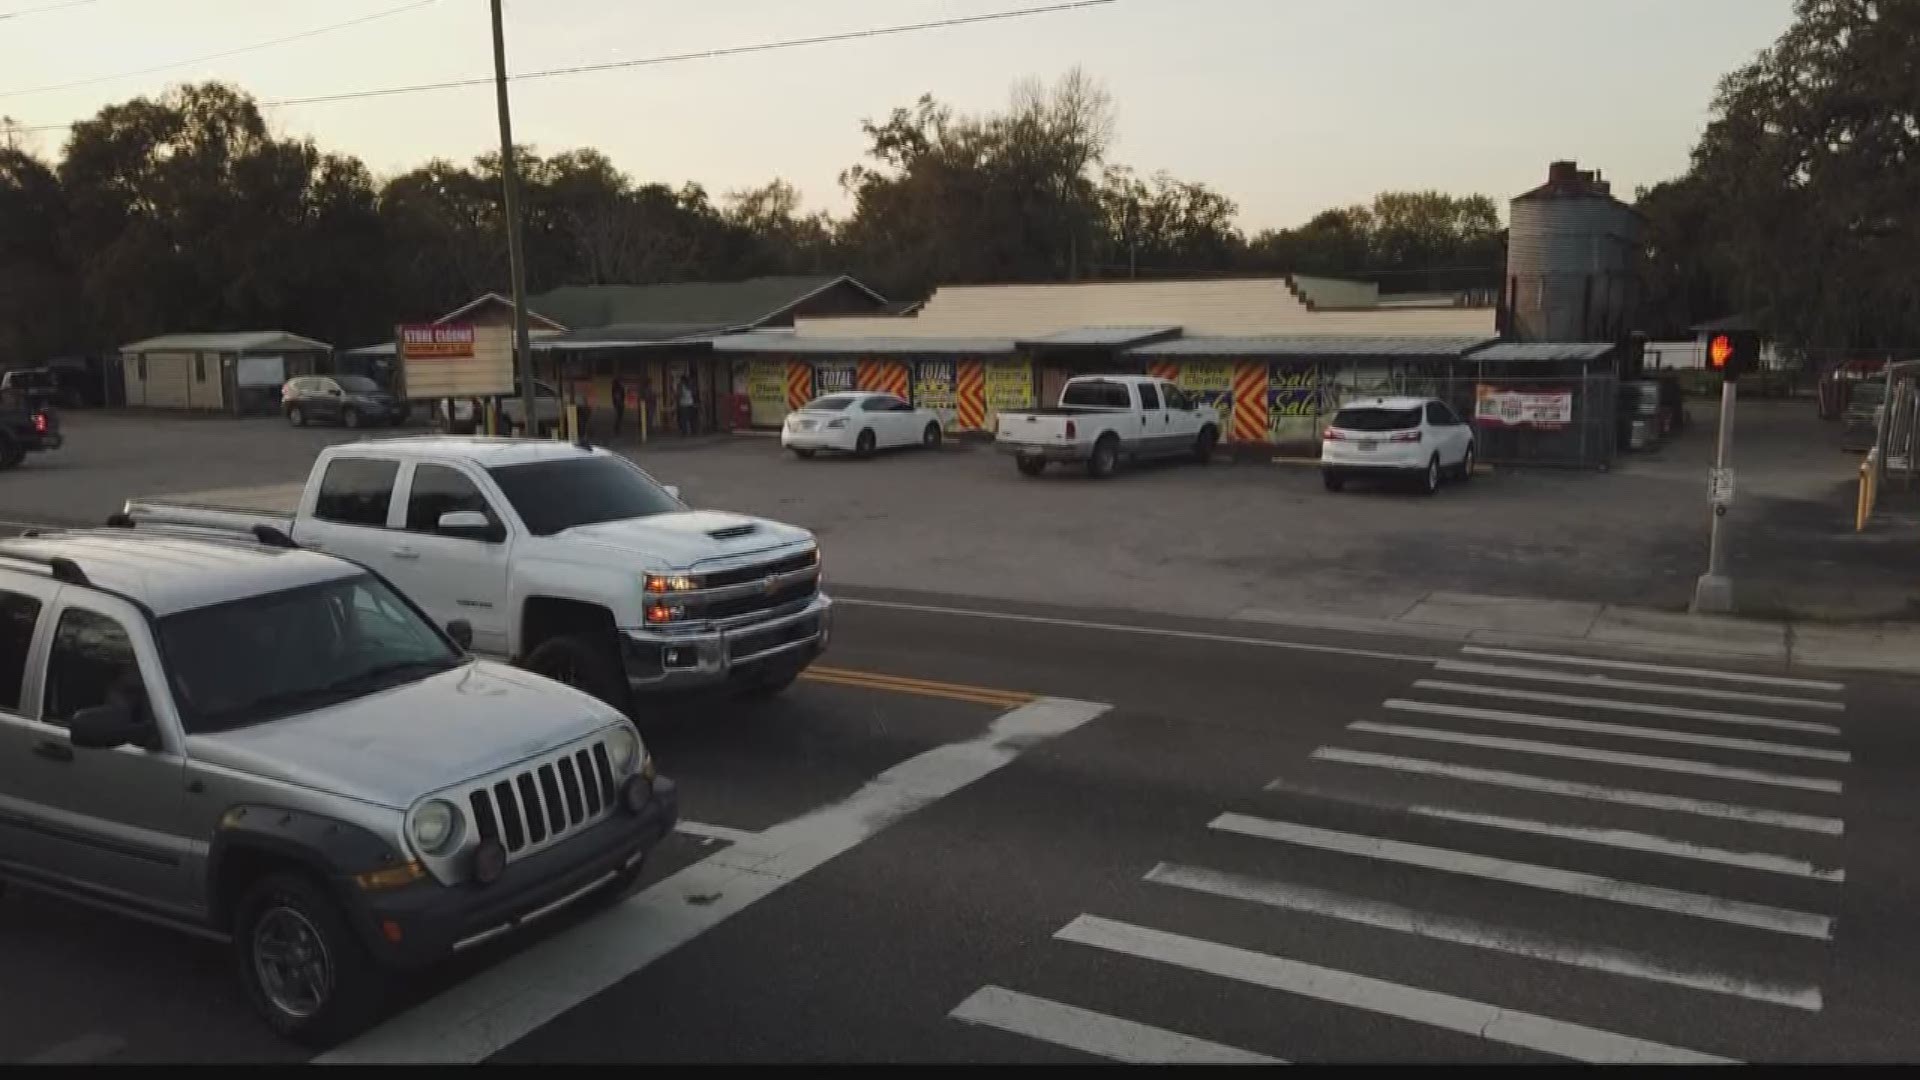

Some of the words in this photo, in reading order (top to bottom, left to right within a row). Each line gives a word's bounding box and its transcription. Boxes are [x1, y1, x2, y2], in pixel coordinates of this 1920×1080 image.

[822, 370, 852, 386] TOTAL
[920, 362, 951, 380] TOTAL
[1270, 367, 1314, 386] Sale
[1270, 390, 1315, 415] Sale
